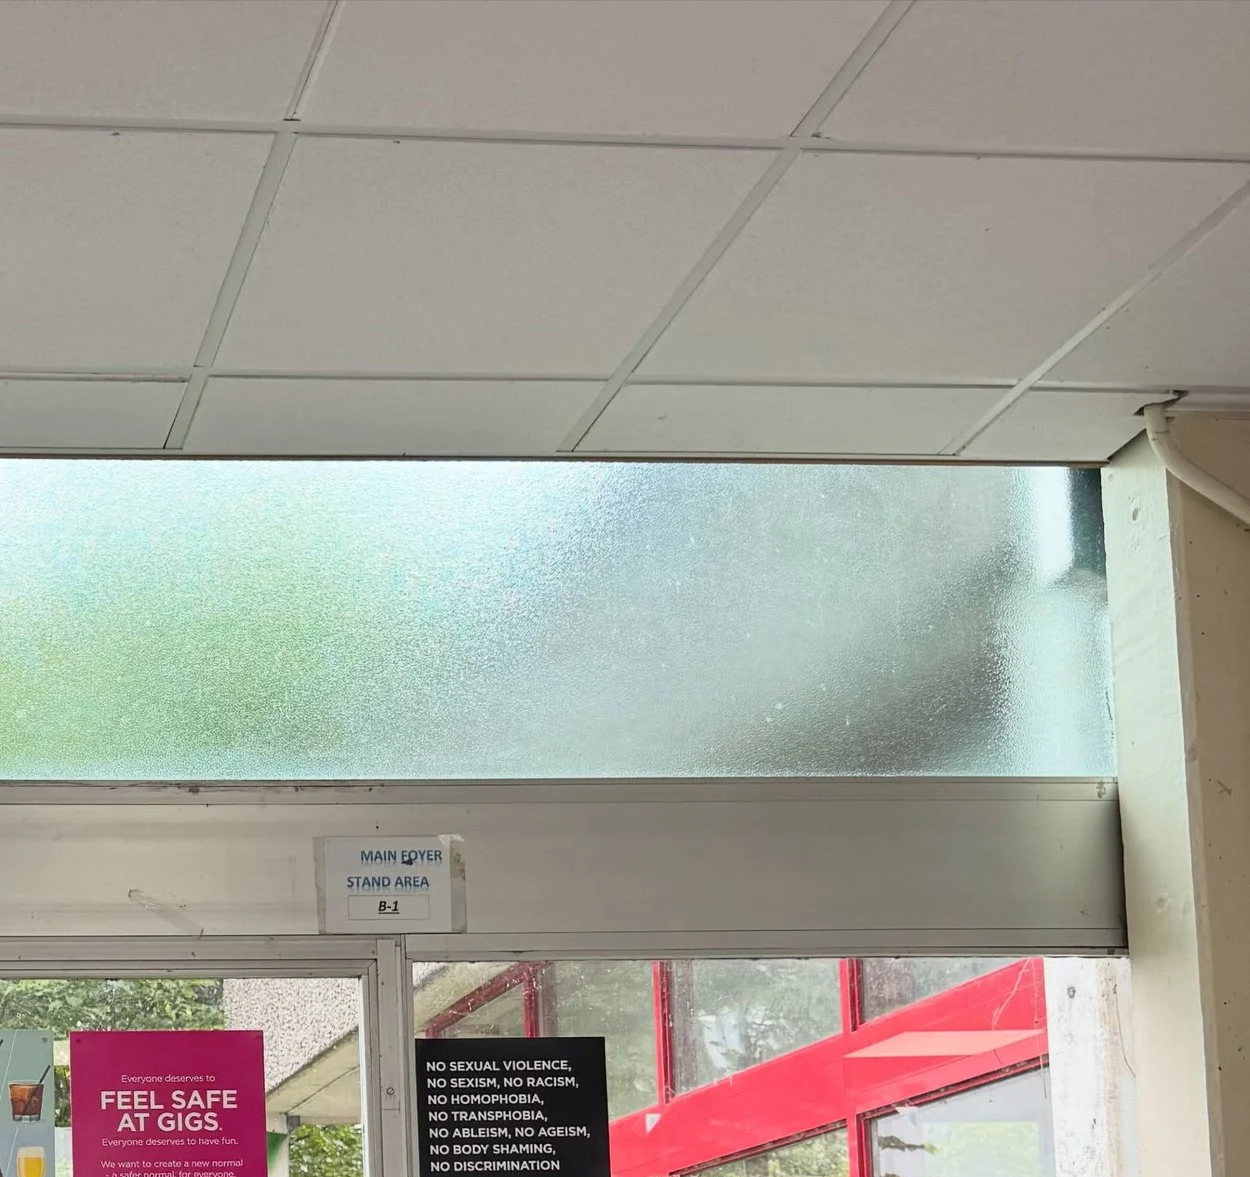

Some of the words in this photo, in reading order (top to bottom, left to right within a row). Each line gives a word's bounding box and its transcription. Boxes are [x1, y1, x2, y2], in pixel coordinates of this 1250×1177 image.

[361, 851, 397, 861] MAIN
[402, 850, 442, 861] FOYER
[347, 876, 391, 888] STAND
[395, 876, 429, 887] AREA
[378, 901, 399, 911] B-1
[426, 1062, 446, 1071] NO
[450, 1061, 500, 1071] SEXUAL
[503, 1060, 572, 1071] VIOLENCE,
[122, 1075, 162, 1084] Everyone
[165, 1074, 203, 1082] deserves
[427, 1078, 446, 1088] NO
[450, 1078, 500, 1088] SEXISM,
[504, 1078, 523, 1087] NO
[527, 1077, 579, 1088] RACISM,
[100, 1091, 164, 1110] FEEL
[171, 1090, 237, 1109] SAFE
[428, 1095, 447, 1105] NO
[451, 1094, 544, 1105] HOMOPHOBIA,
[429, 1112, 448, 1121] NO
[452, 1111, 547, 1122] TRANSPHOBIA,
[117, 1113, 149, 1132] AT
[157, 1113, 222, 1131] GIGS.
[429, 1128, 449, 1138] NO
[453, 1128, 511, 1139] ABLEISM,
[515, 1128, 534, 1137] NO
[538, 1127, 590, 1138] AGEISM,
[102, 1138, 143, 1147] Everyone
[146, 1138, 184, 1146] deserves
[199, 1138, 219, 1146] have
[222, 1137, 238, 1145] fun.
[430, 1145, 449, 1155] NO
[453, 1145, 489, 1154] BODY
[493, 1144, 556, 1155] SHAMING,
[212, 1159, 243, 1167] normal
[430, 1162, 450, 1172] NO
[454, 1160, 560, 1171] DISCRIMINATION
